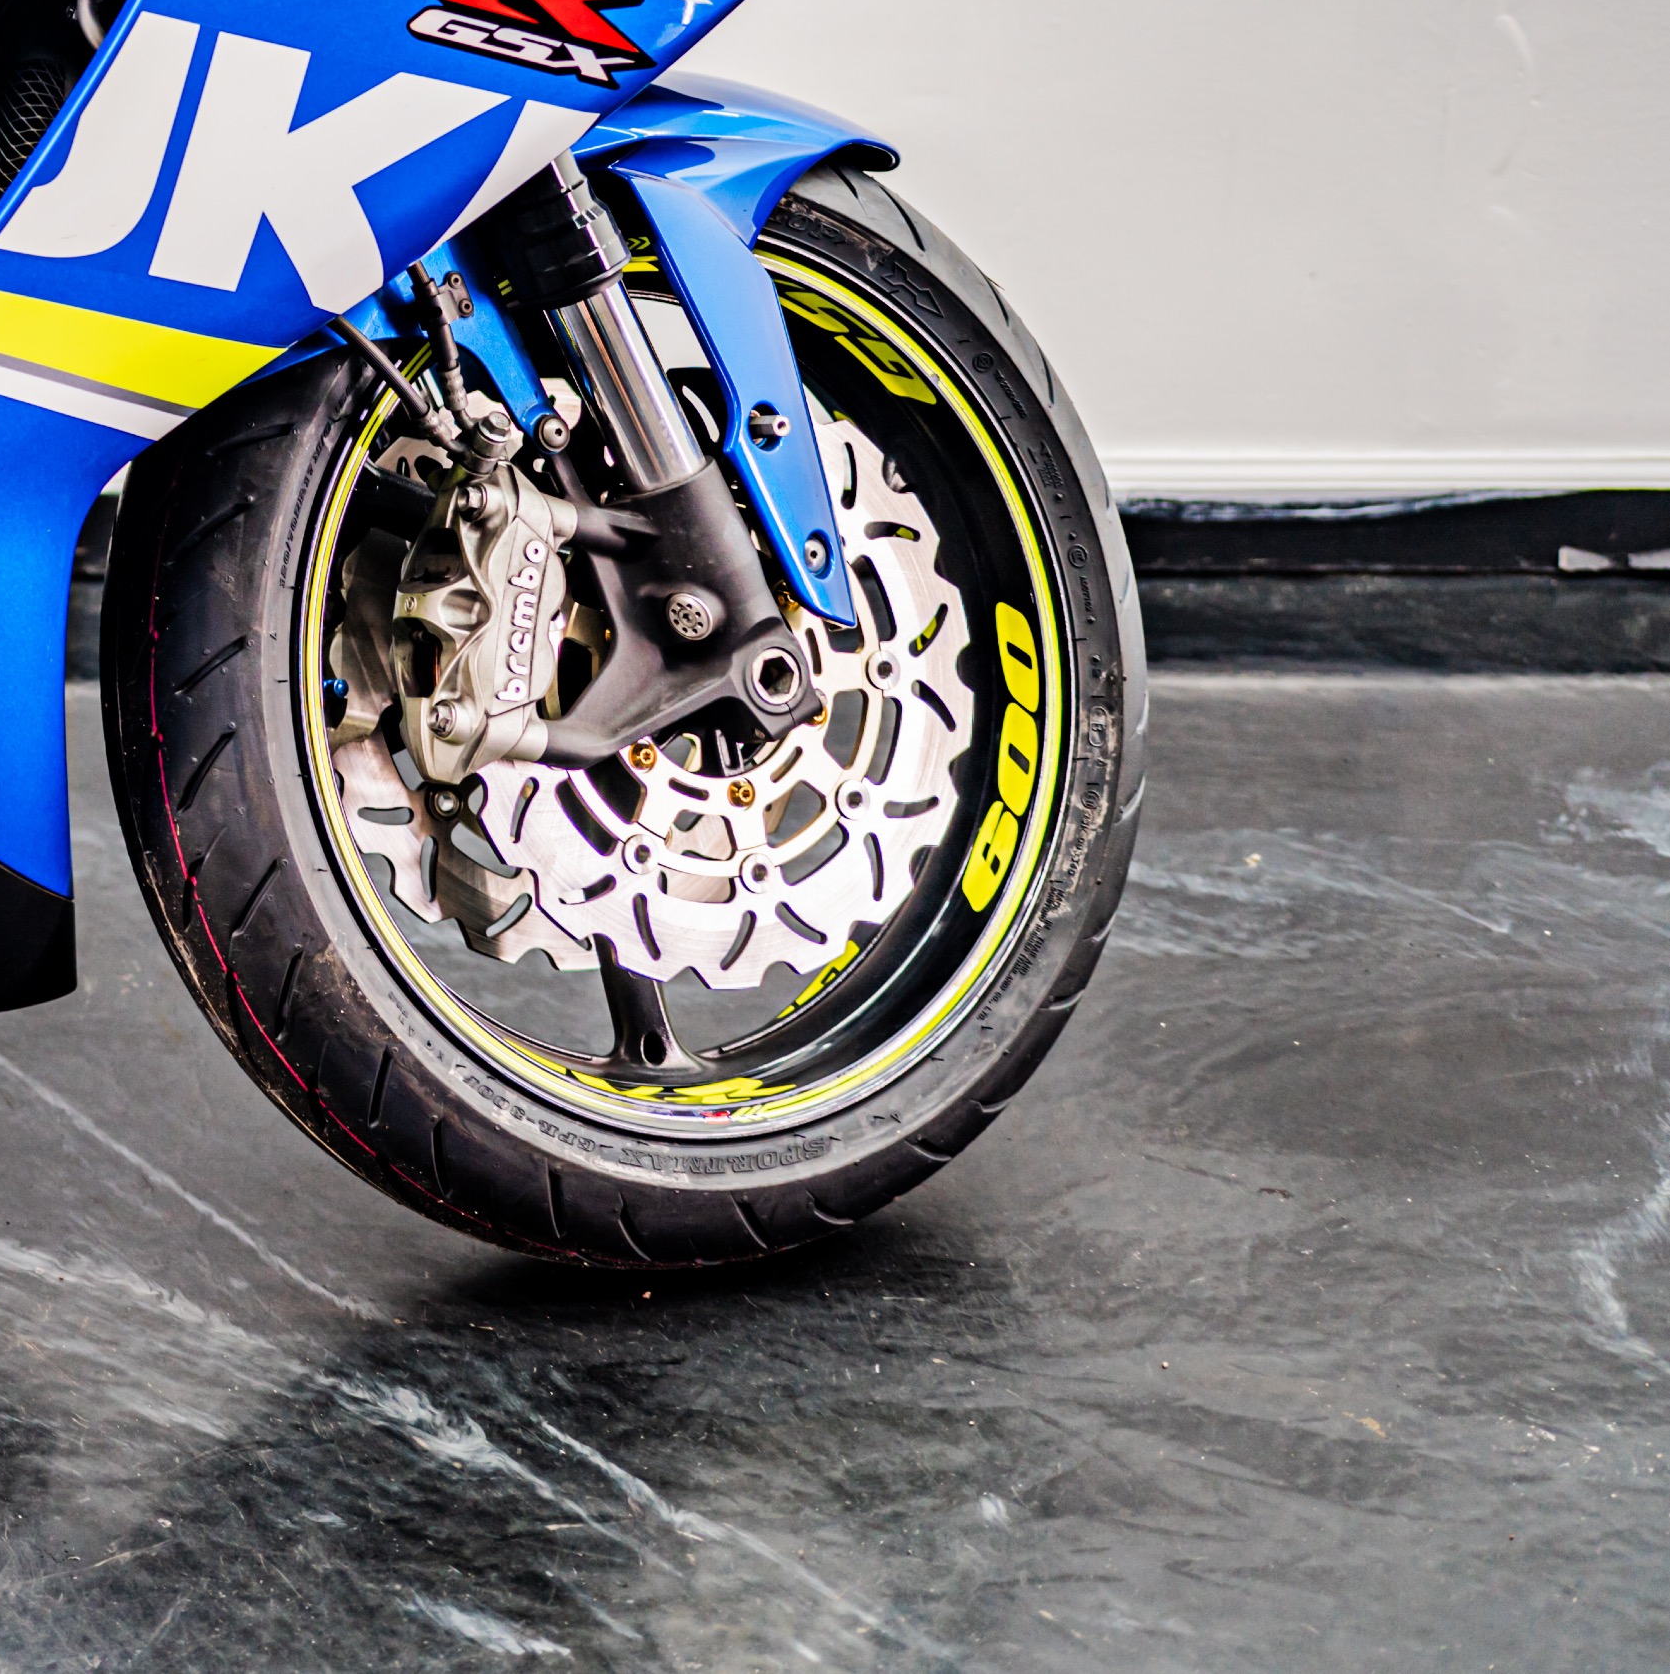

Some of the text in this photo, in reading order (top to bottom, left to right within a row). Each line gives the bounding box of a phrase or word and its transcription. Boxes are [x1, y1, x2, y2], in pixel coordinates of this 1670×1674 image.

[409, 8, 636, 82] GSX
[497, 539, 547, 702] brembo
[962, 602, 1040, 913] 600
[618, 1135, 827, 1176] SPORTMAX
